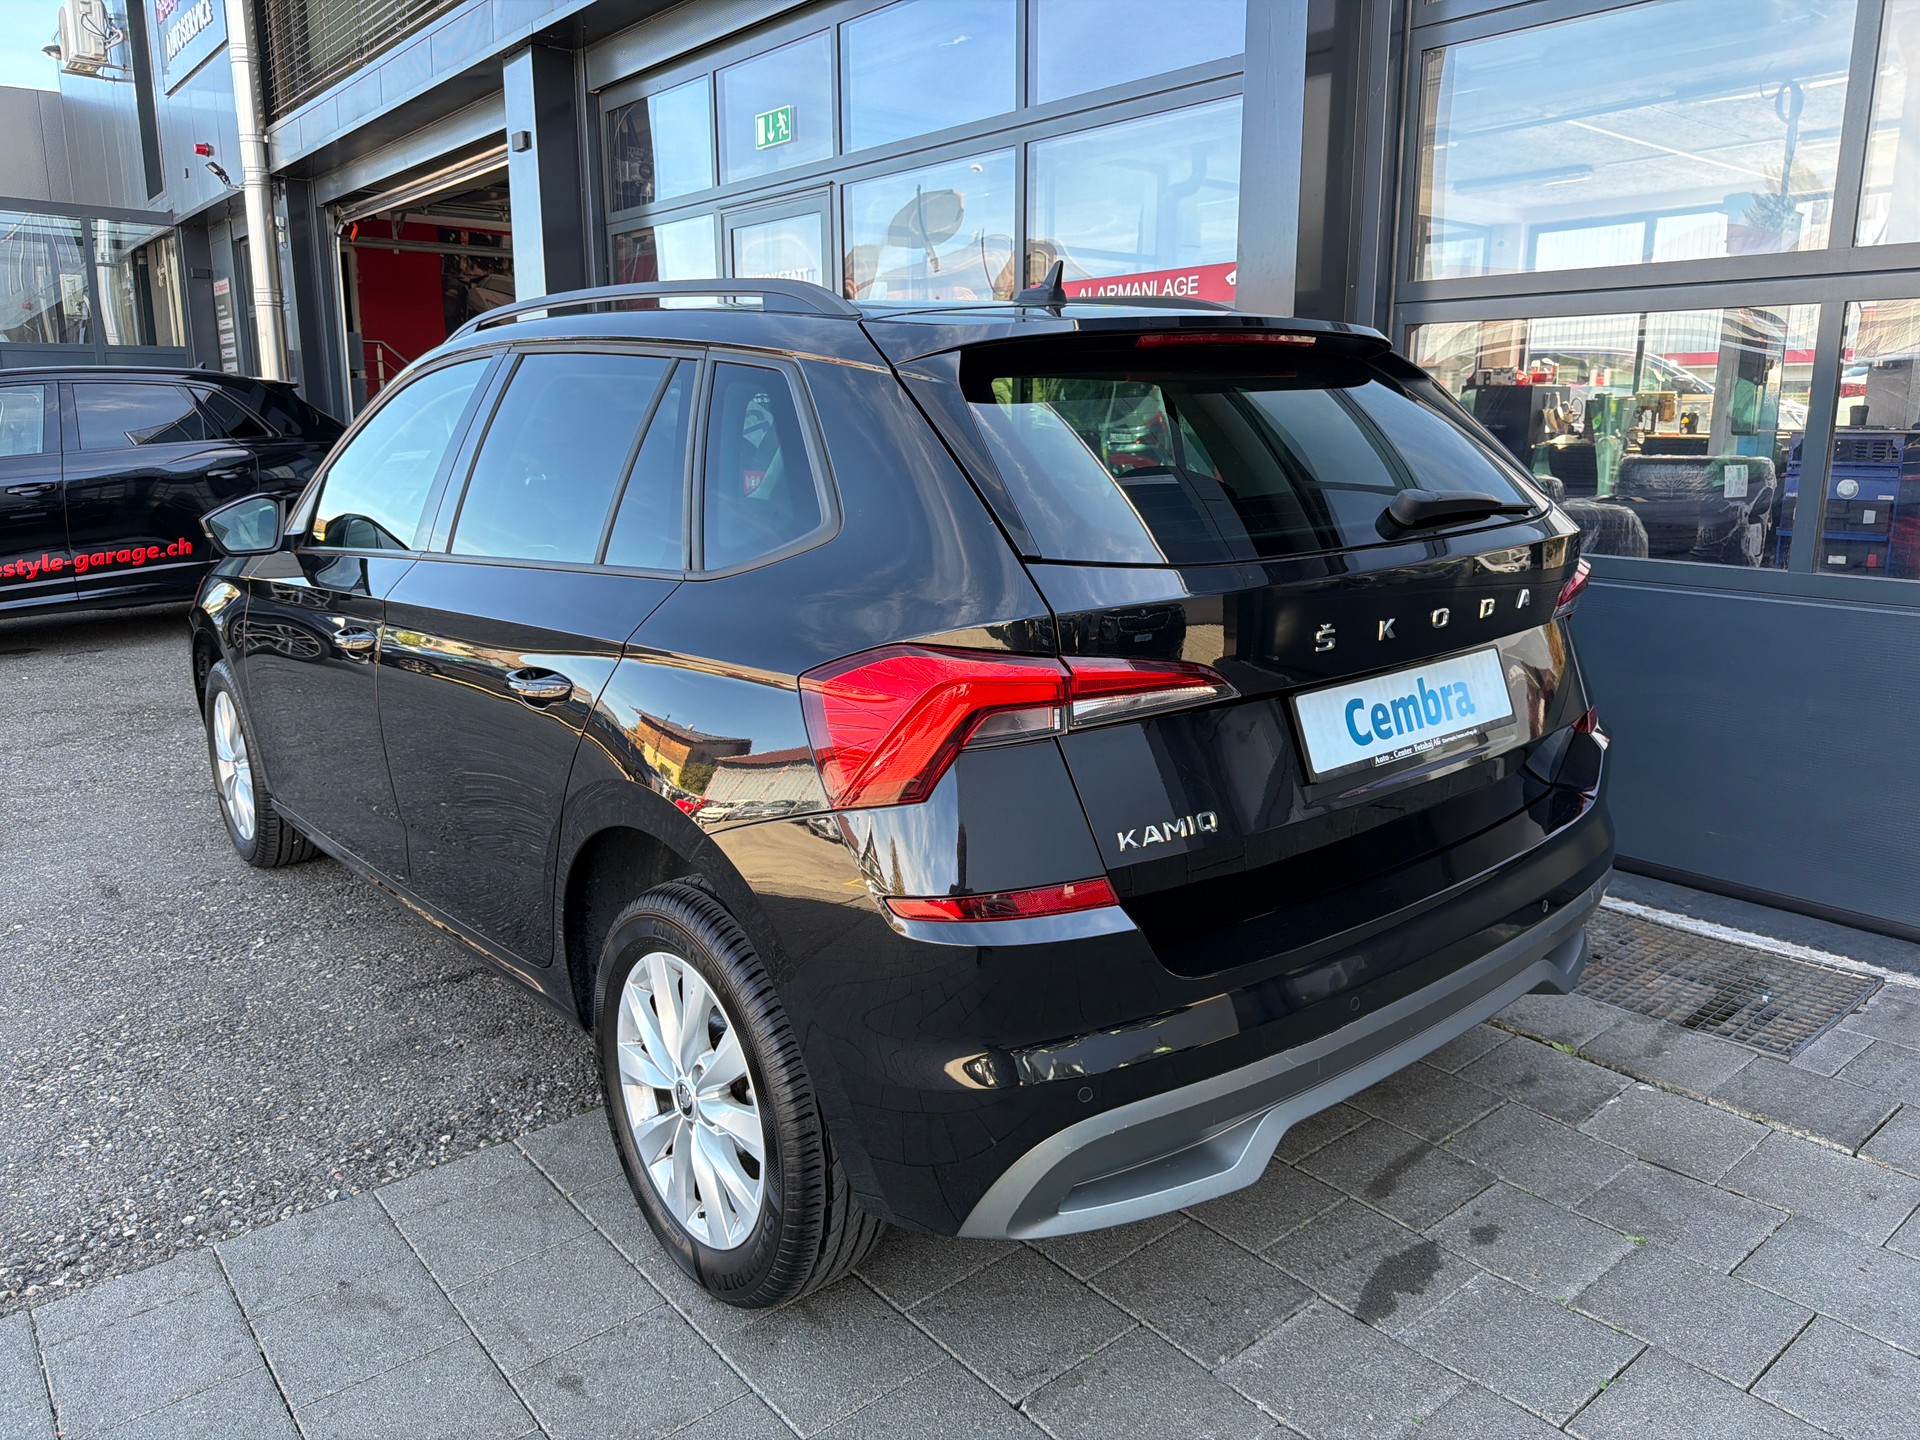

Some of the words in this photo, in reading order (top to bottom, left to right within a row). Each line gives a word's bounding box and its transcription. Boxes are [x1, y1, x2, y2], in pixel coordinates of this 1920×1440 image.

[1315, 588, 1531, 653] ŠKODA
[1345, 677, 1476, 747] Cembra
[1393, 748, 1413, 758] Center
[1433, 737, 1442, 747] AG
[1117, 811, 1218, 852] KAMIQ
